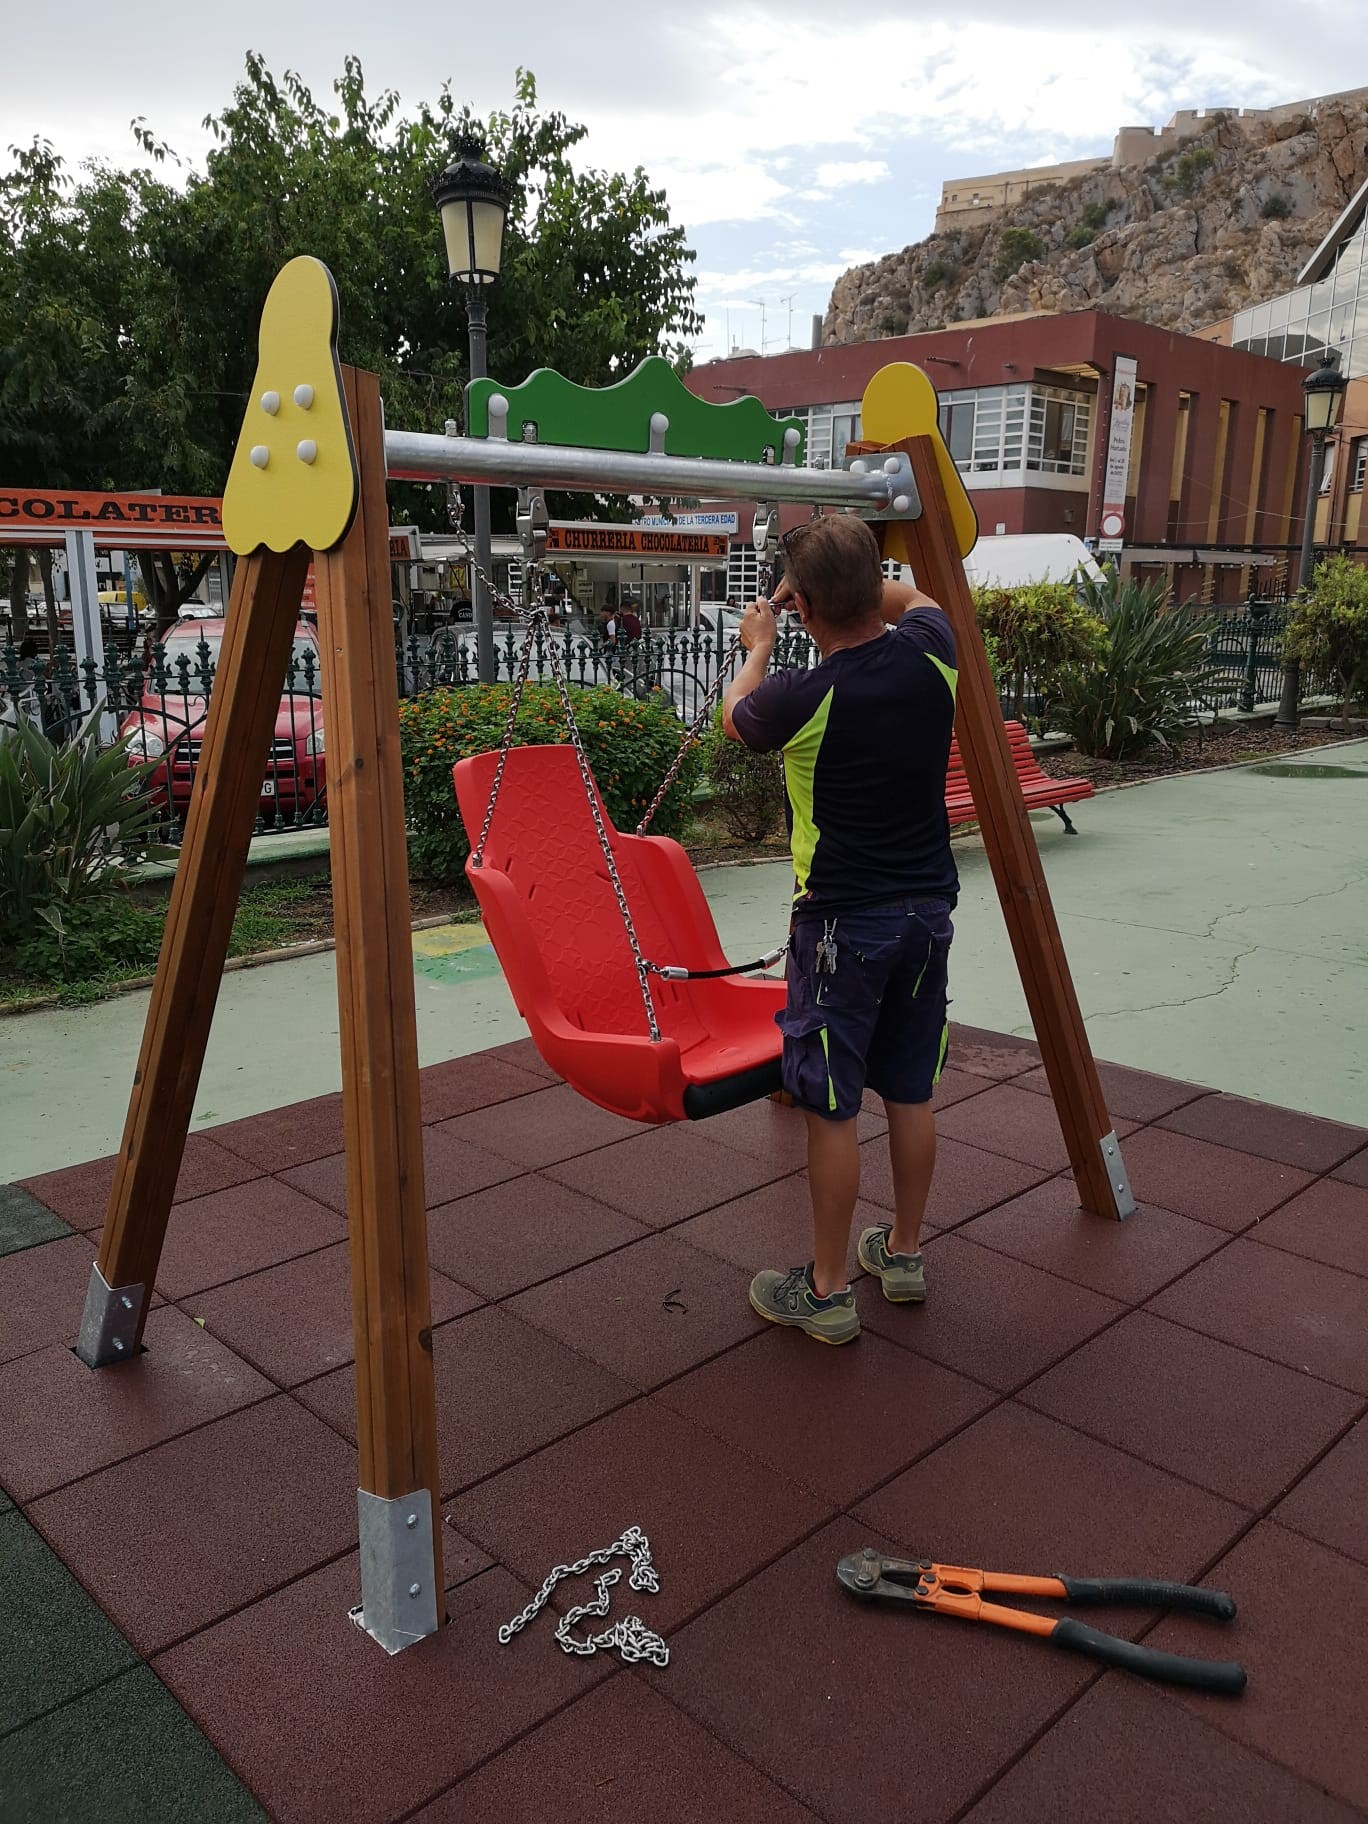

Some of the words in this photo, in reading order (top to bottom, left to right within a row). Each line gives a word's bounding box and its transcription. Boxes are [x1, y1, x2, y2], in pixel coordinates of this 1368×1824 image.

[678, 516, 686, 525] DE
[687, 516, 694, 525] LA
[694, 515, 719, 525] TERCERA
[720, 514, 735, 524] EDAD
[564, 530, 637, 550] CHURRERIA
[641, 533, 710, 553] CHOCOLATERIA
